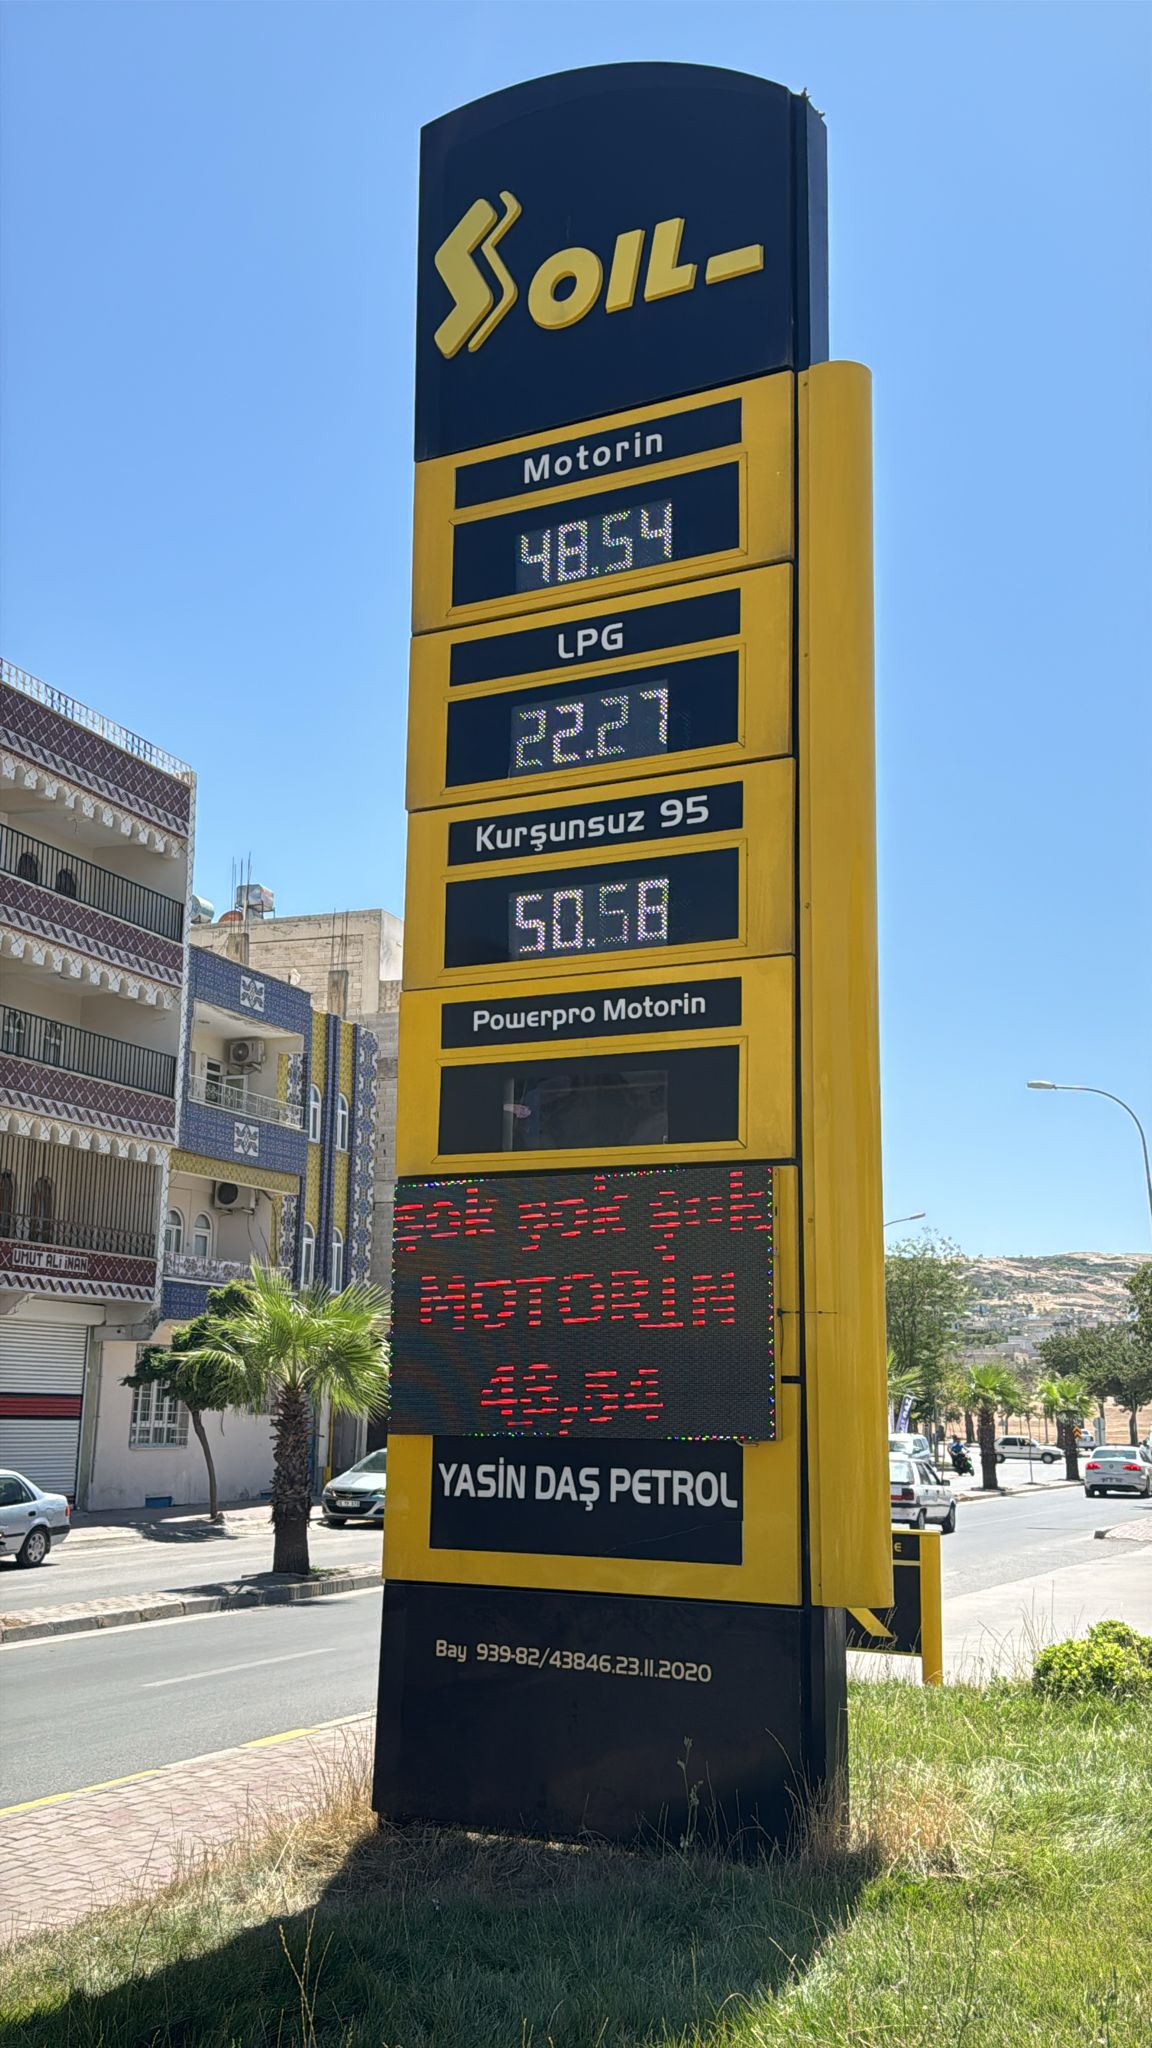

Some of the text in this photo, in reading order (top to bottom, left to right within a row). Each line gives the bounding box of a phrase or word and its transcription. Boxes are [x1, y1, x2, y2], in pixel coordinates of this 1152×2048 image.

[523, 432, 663, 484] Motorin
[520, 500, 673, 583] 48.54
[557, 622, 624, 660] LPG
[515, 688, 669, 768] 22.27
[476, 795, 709, 852] Kurşunsuz 95
[515, 878, 669, 953] 50.58
[473, 993, 706, 1033] Powerpro Motorin
[13, 1249, 43, 1266] UMUT
[439, 1457, 738, 1511] YASİN DAŞ PETROL
[435, 1639, 467, 1663] Bay
